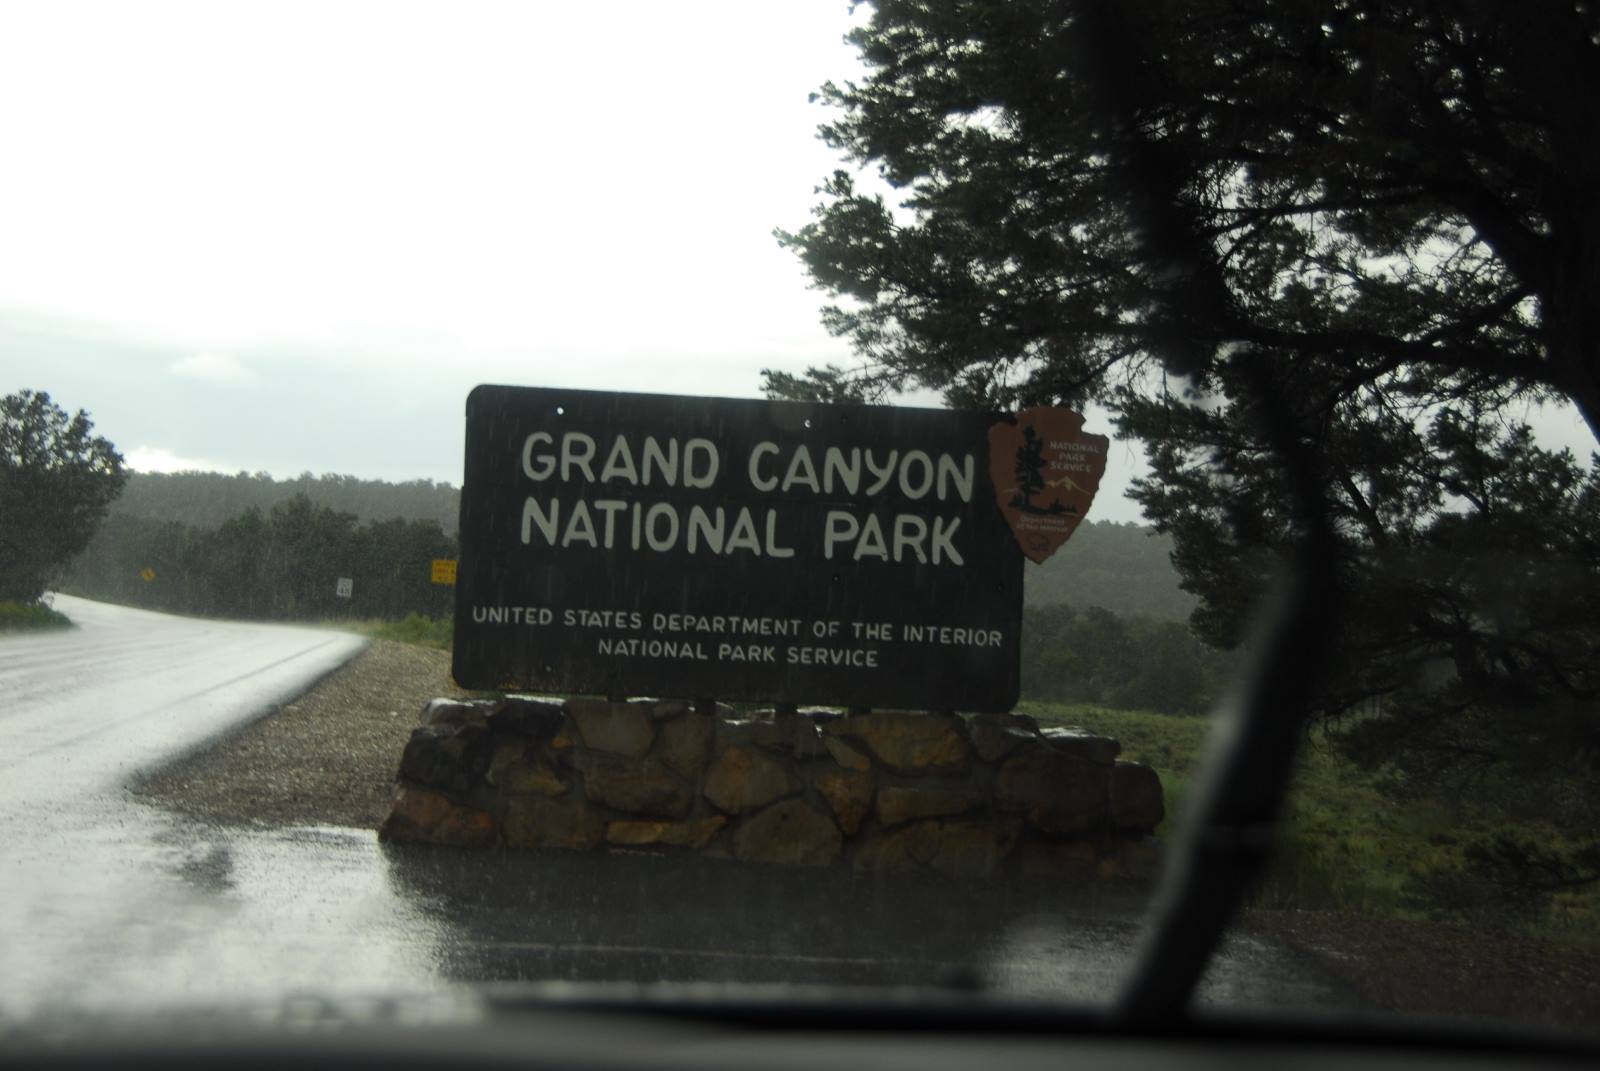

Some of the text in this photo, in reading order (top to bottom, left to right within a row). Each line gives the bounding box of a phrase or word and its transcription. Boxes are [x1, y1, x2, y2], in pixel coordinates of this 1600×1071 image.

[1050, 441, 1100, 454] NATIONAL
[1059, 452, 1086, 462] PARK
[521, 431, 975, 503] GRAND CANYON
[1050, 461, 1092, 473] SERVICE
[520, 495, 964, 566] NATIONAL PARK
[472, 606, 1002, 647] UNITED STATES DEPARTMENT OF THE INTERIOR
[598, 639, 878, 667] NATIONAL PARK SERVICE
